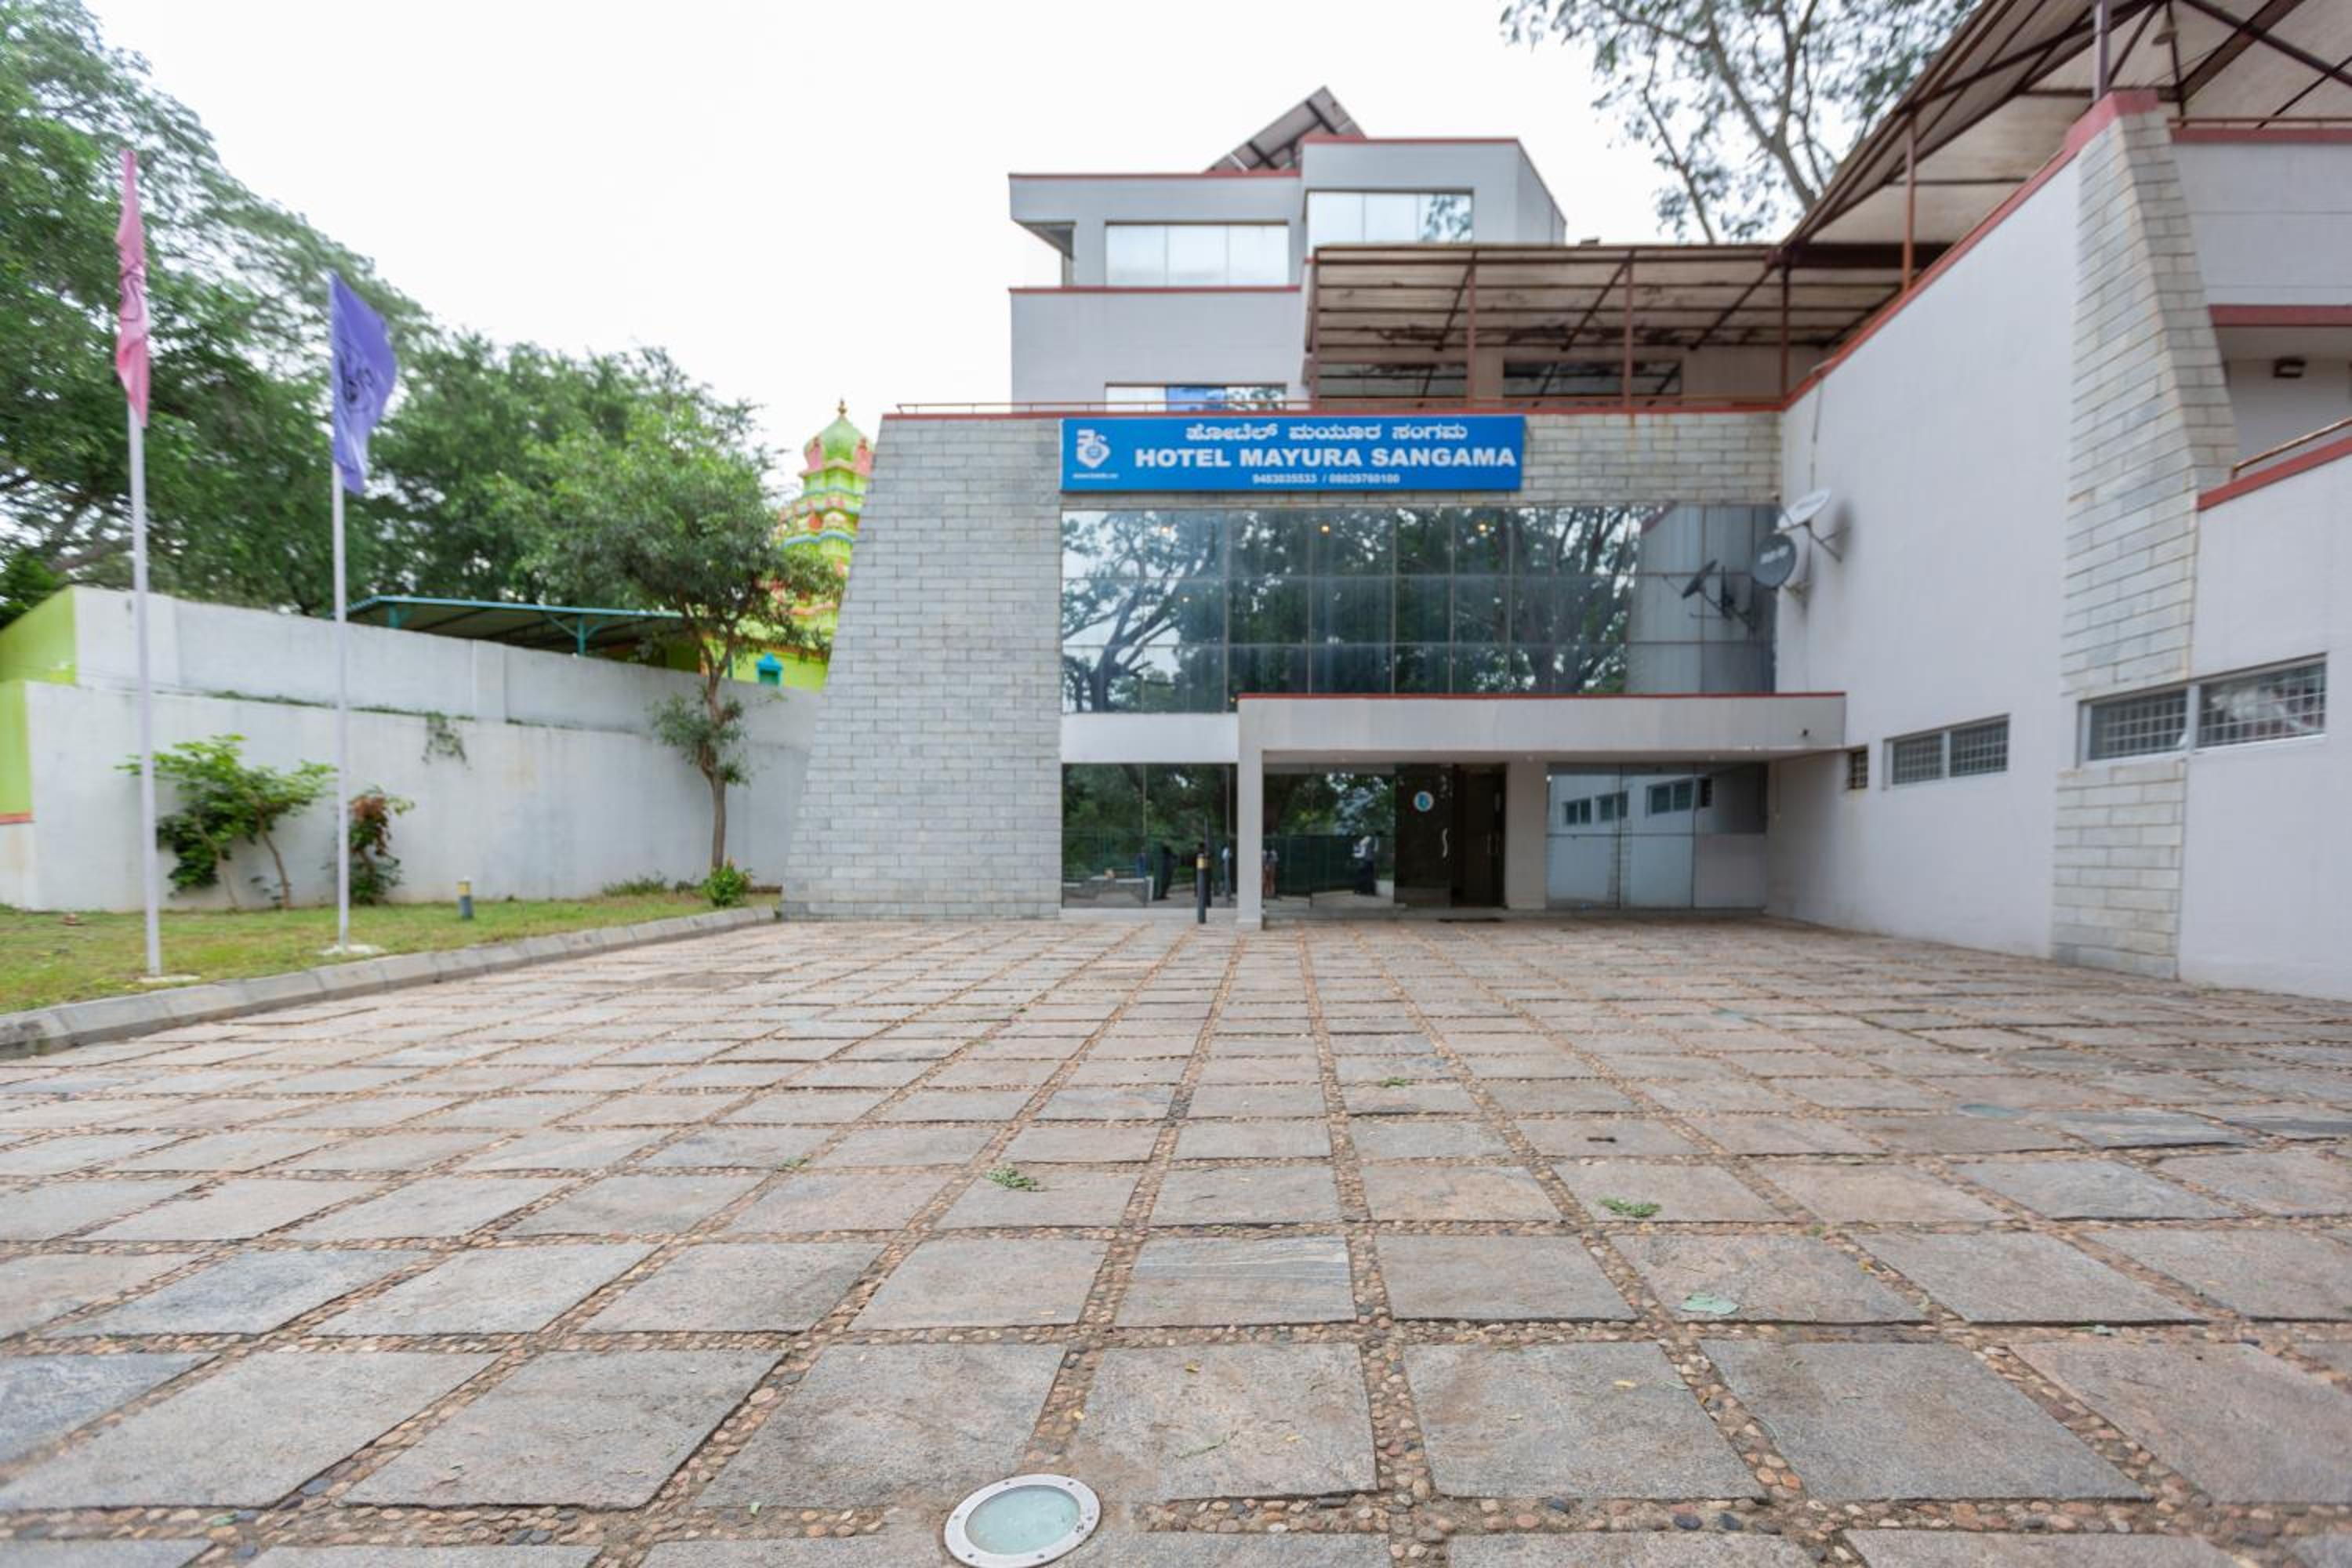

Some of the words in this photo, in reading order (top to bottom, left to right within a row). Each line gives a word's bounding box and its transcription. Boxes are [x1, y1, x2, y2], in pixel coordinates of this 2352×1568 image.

[1185, 423, 1279, 441] ಹೋಟೆಲ್
[1289, 423, 1381, 441] ಮಯೂರ
[1392, 423, 1468, 441] ಸಂಗಮ
[1135, 448, 1232, 467] HOTEL
[1239, 448, 1363, 467] MAYURA
[1371, 447, 1517, 466] SANGAMA
